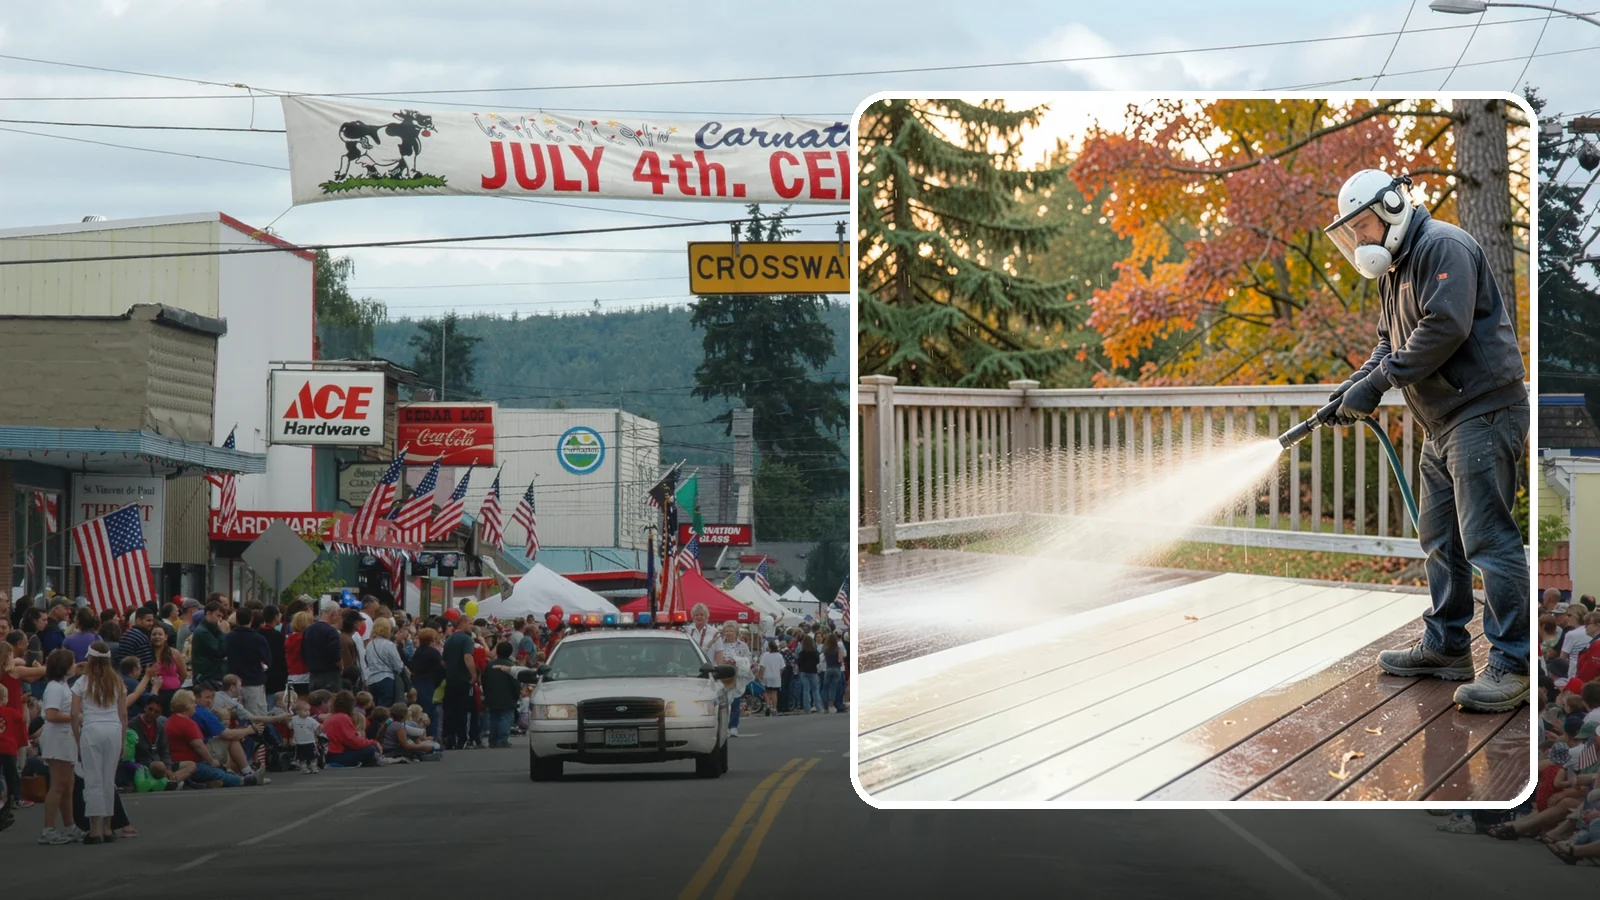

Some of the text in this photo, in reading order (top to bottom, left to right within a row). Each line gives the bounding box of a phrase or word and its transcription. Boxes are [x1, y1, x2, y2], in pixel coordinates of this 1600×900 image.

[695, 121, 850, 149] Carnat
[481, 140, 605, 193] JULY
[632, 149, 747, 198] 4th.
[697, 254, 850, 280] CROSSWA
[282, 380, 373, 420] ACE
[406, 409, 453, 422] CEDAR
[283, 421, 371, 437] Hardware
[95, 485, 124, 495] Vincent
[126, 486, 136, 494] de
[138, 486, 155, 496] Paul
[688, 526, 742, 535] CRNATION
[699, 535, 731, 543] GLASS
